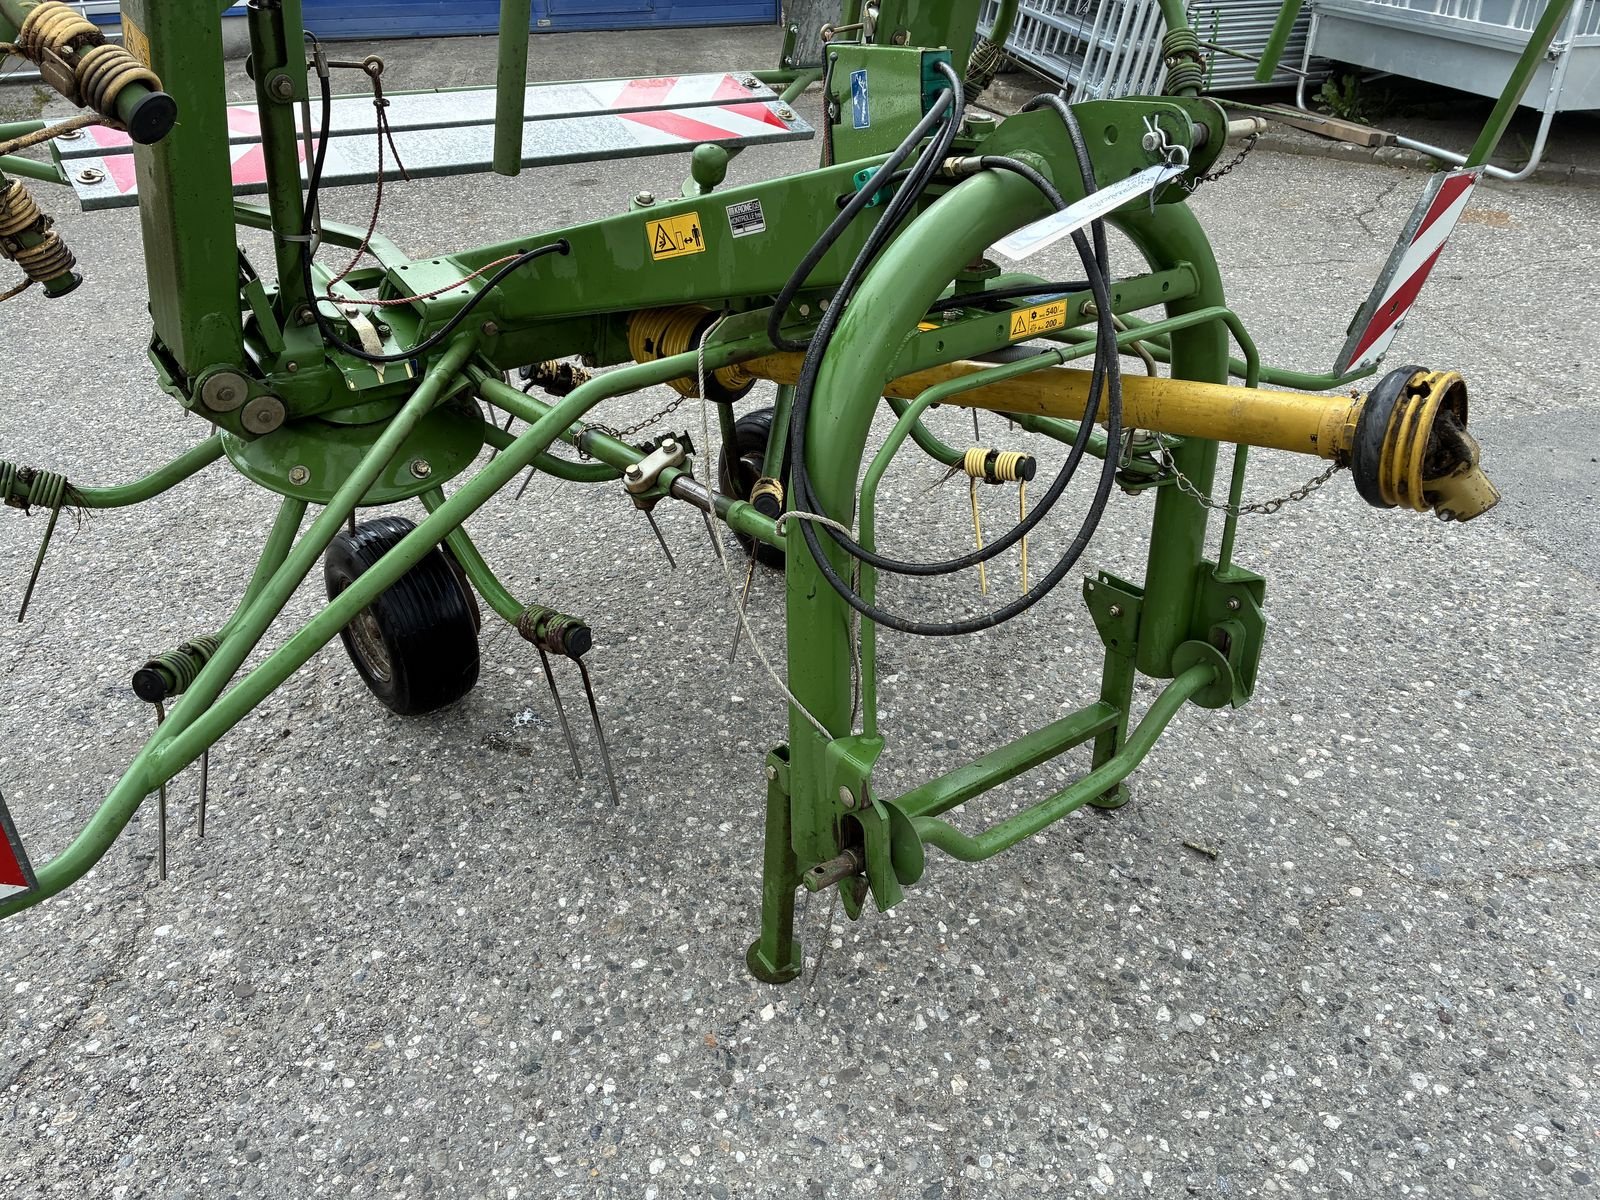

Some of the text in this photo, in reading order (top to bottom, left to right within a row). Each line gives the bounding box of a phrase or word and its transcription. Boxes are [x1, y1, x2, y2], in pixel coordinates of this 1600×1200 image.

[734, 203, 752, 214] KRONE
[731, 212, 755, 224] KONTROLLE
[1045, 318, 1058, 329] 200
